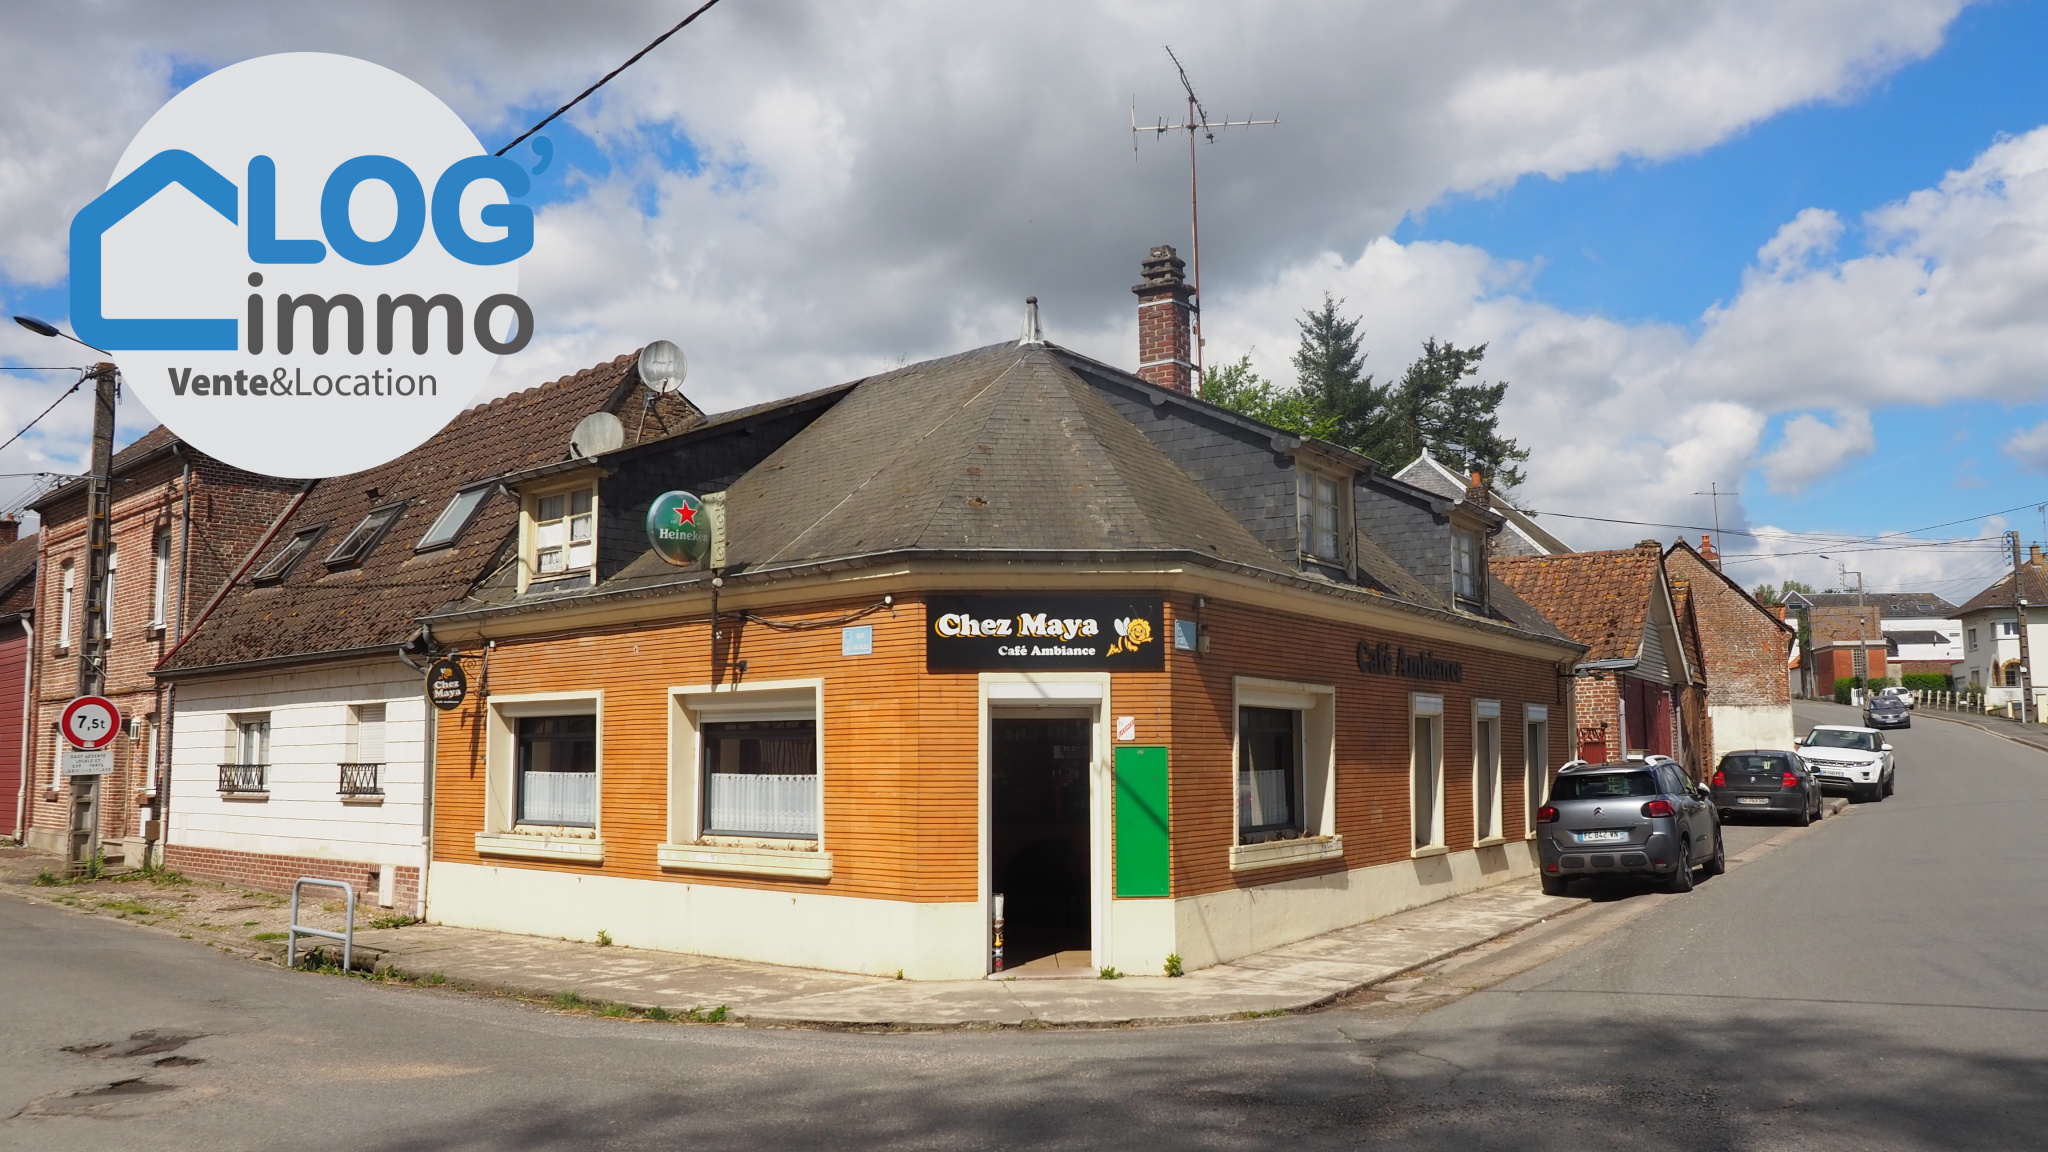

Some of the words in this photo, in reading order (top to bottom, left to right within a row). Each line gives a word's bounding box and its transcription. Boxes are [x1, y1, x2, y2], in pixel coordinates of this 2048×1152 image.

[659, 528, 708, 542] Heineken
[935, 613, 1012, 638] Chez
[1017, 613, 1099, 642] Maya
[998, 645, 1028, 656] Café
[1030, 645, 1096, 656] Ambiance
[1357, 640, 1392, 675] Café
[1396, 645, 1463, 683] Ambiance
[433, 681, 460, 690] Chez
[433, 688, 462, 699] Maya
